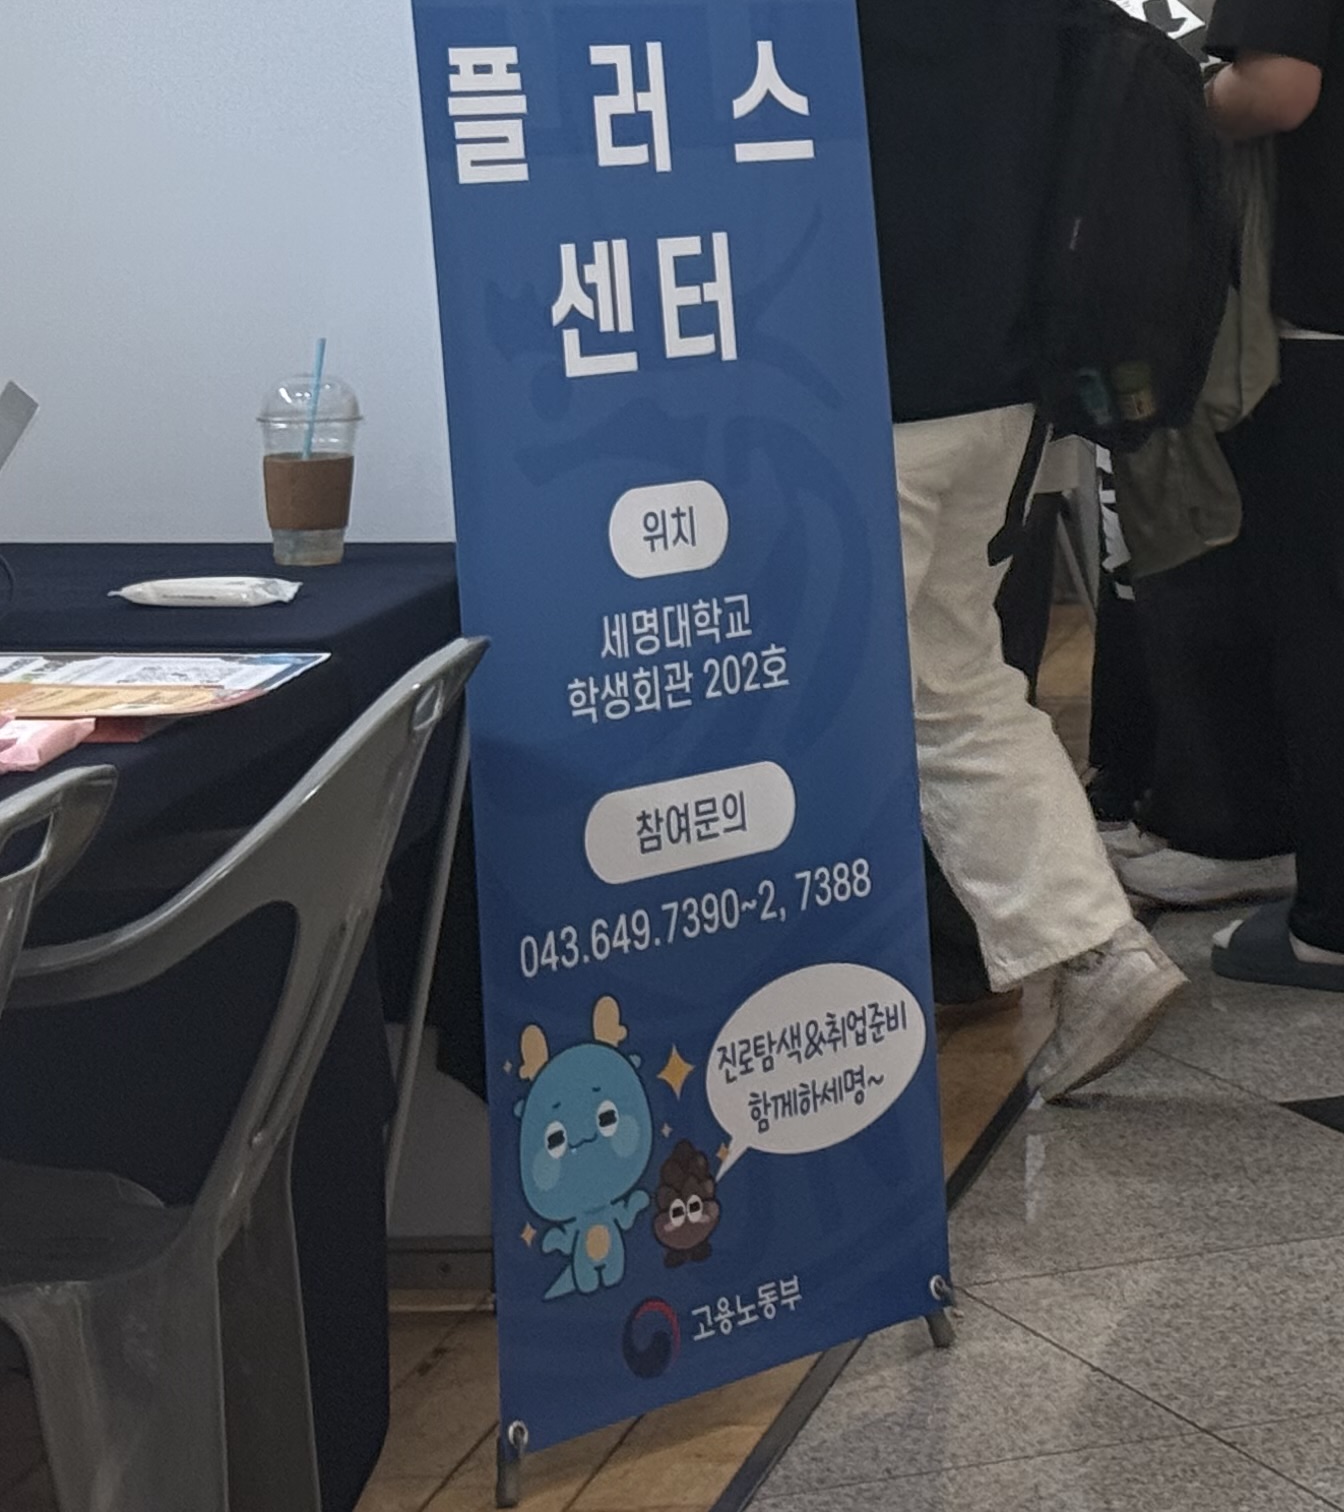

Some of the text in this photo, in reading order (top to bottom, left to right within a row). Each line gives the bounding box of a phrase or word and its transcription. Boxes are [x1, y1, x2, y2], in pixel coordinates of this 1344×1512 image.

[551, 231, 739, 378] 센터
[641, 505, 697, 552] 위치
[600, 593, 753, 660] 세명대학교
[567, 642, 790, 724] 학생회관 202호
[635, 790, 748, 855] 참여문의
[519, 856, 872, 979] 043.649.7390~2, 7388
[715, 1000, 908, 1085] 진로탐색&취업준비
[747, 1063, 886, 1134] 함께하세명~
[690, 1274, 803, 1342] 고용노동부
